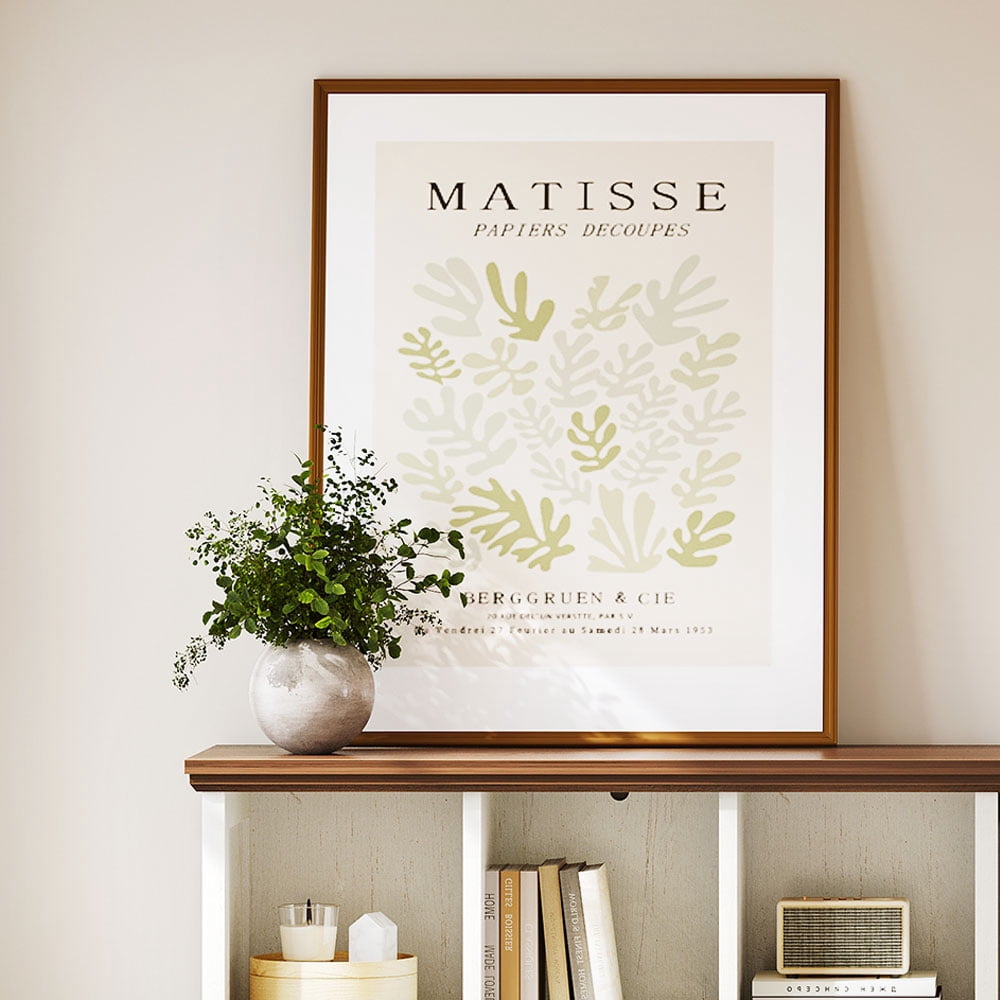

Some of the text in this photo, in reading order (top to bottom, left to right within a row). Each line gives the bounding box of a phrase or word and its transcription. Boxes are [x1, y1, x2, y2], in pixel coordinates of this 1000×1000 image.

[427, 181, 727, 211] MATISSE
[473, 223, 690, 237] PAPIERS DECOUPES
[464, 591, 676, 605] BERGGRUEN & CIE
